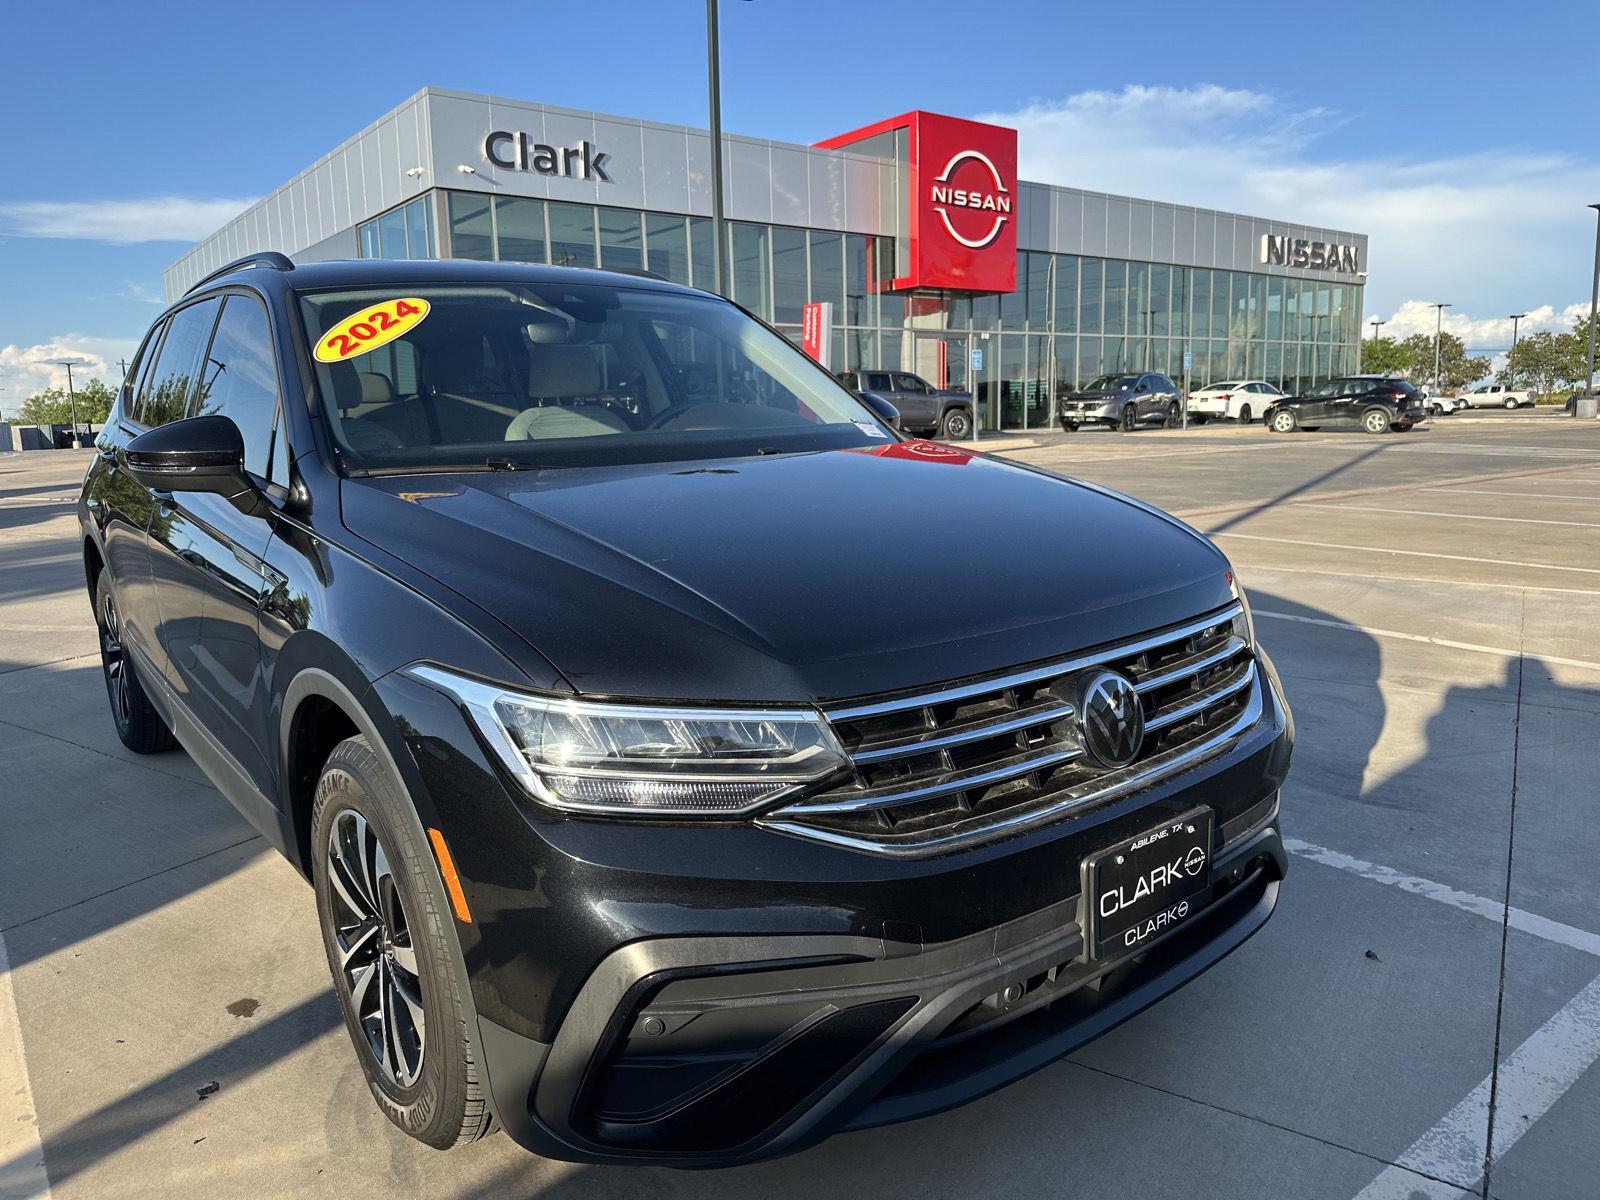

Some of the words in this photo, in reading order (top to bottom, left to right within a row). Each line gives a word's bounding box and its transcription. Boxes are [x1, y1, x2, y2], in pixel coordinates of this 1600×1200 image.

[483, 130, 611, 183] Clark
[932, 185, 1010, 213] NISSAN
[1260, 233, 1358, 273] NISSAN
[327, 300, 420, 357] 2024
[1130, 829, 1169, 852] ABILENE,
[1171, 822, 1184, 834] TX
[1100, 856, 1184, 918] CLARK
[1183, 854, 1206, 869] NISSAN
[1124, 906, 1178, 946] CLARK
